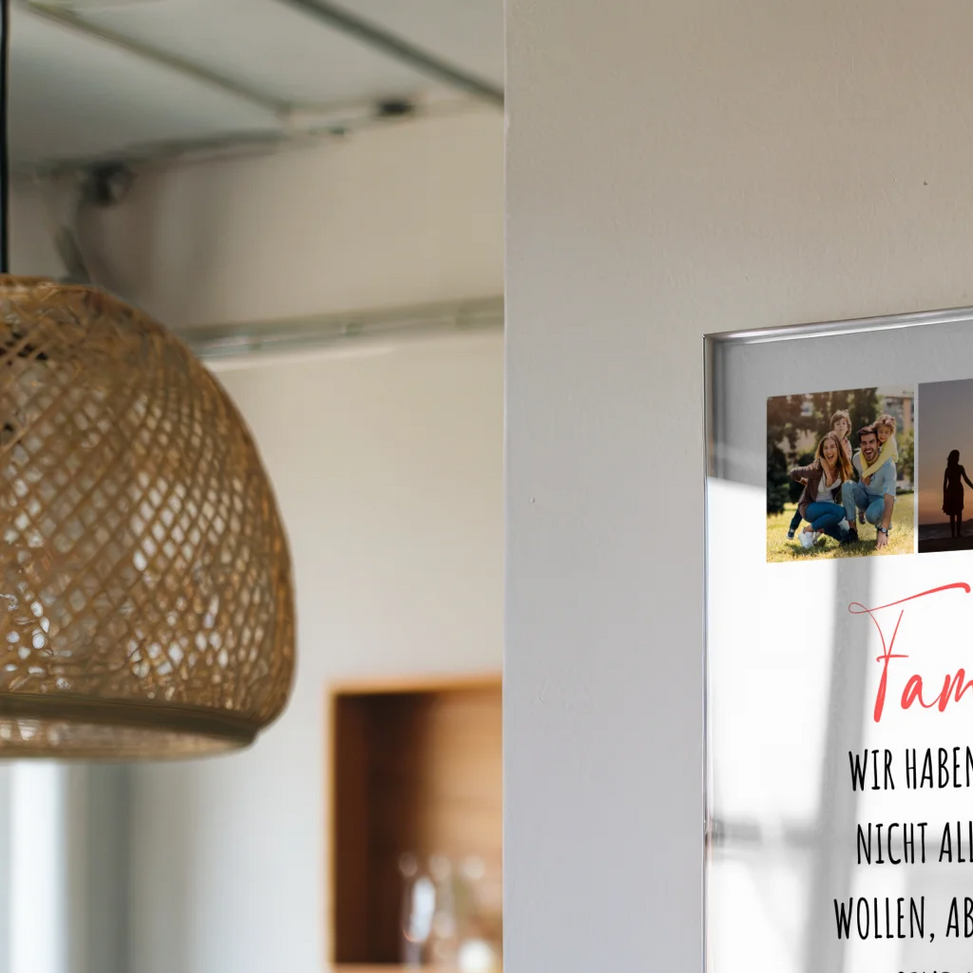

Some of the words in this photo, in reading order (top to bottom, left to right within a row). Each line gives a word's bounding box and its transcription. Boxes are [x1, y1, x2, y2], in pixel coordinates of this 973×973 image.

[848, 748, 895, 792] WIR
[856, 822, 928, 865] NICHT
[833, 895, 935, 943] WOLLEN,
